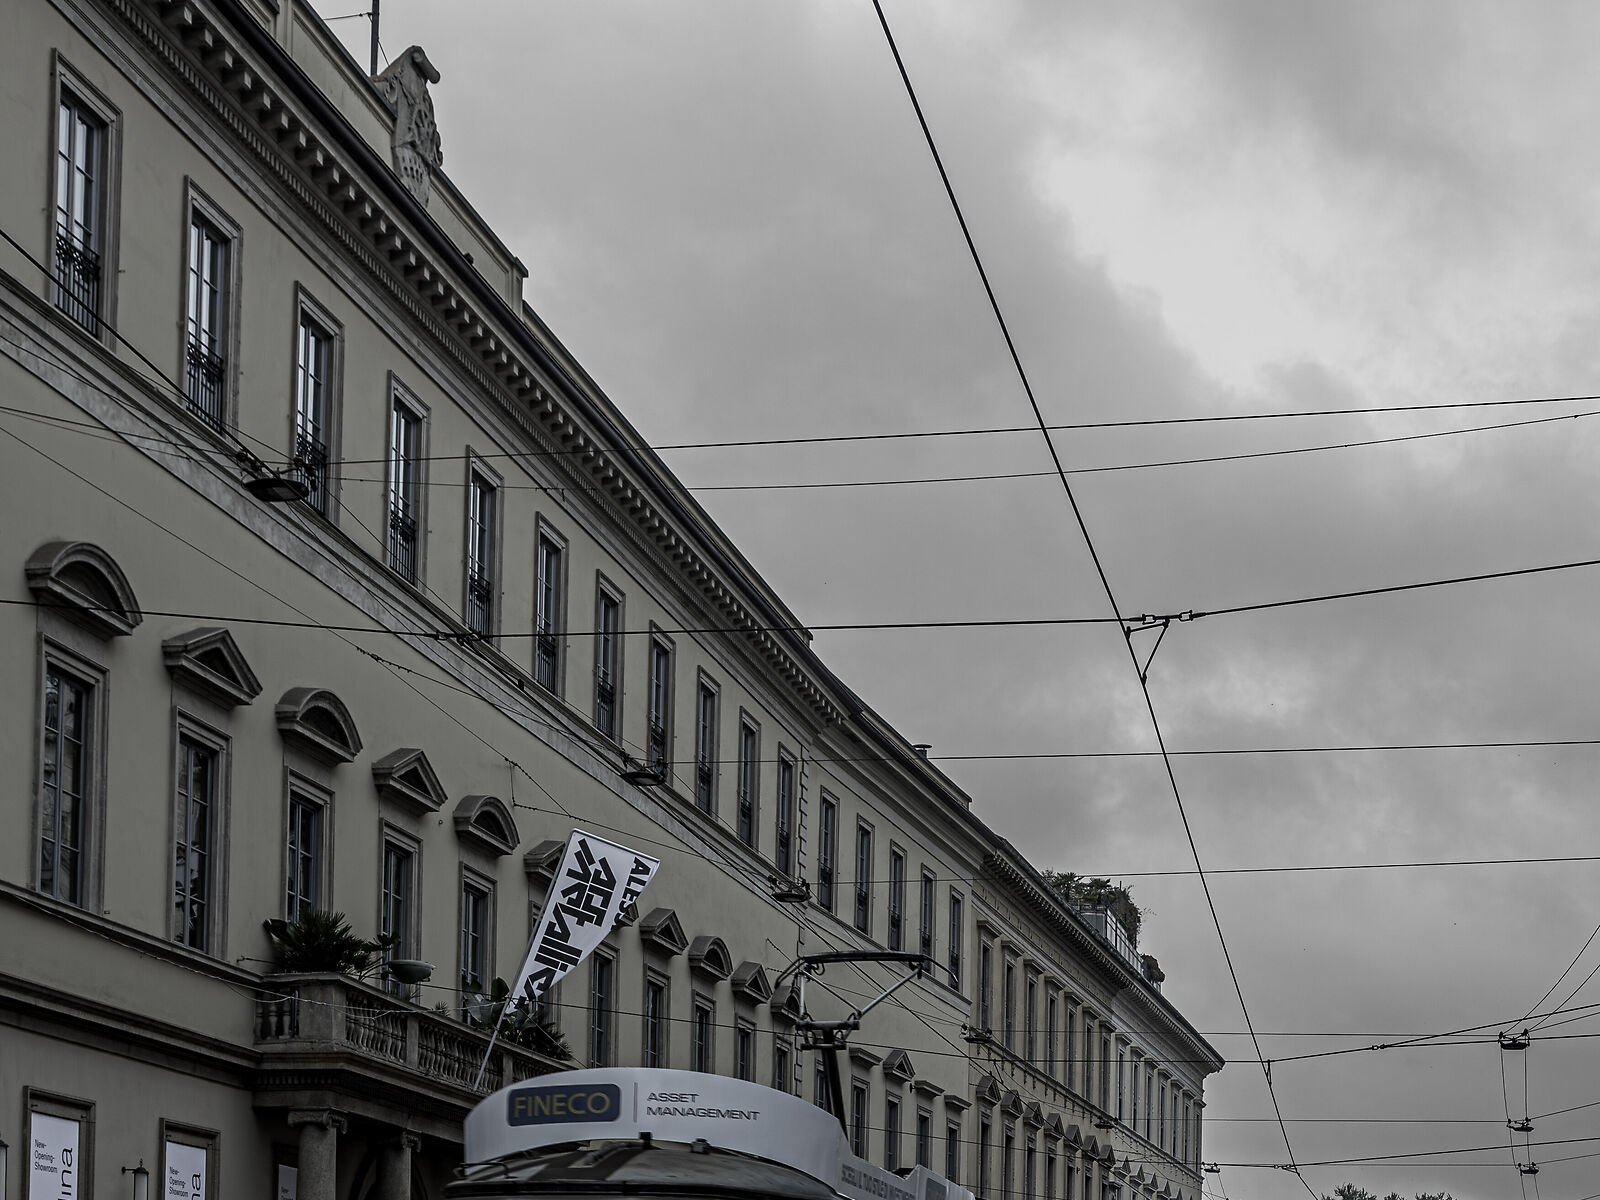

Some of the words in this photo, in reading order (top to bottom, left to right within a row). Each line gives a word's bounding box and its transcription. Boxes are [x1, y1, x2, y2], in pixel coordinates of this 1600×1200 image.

[648, 1093, 699, 1103] ASSET
[513, 1092, 611, 1118] FINECO
[647, 1107, 760, 1121] MANAGEMENT
[34, 1162, 58, 1173] Showroom
